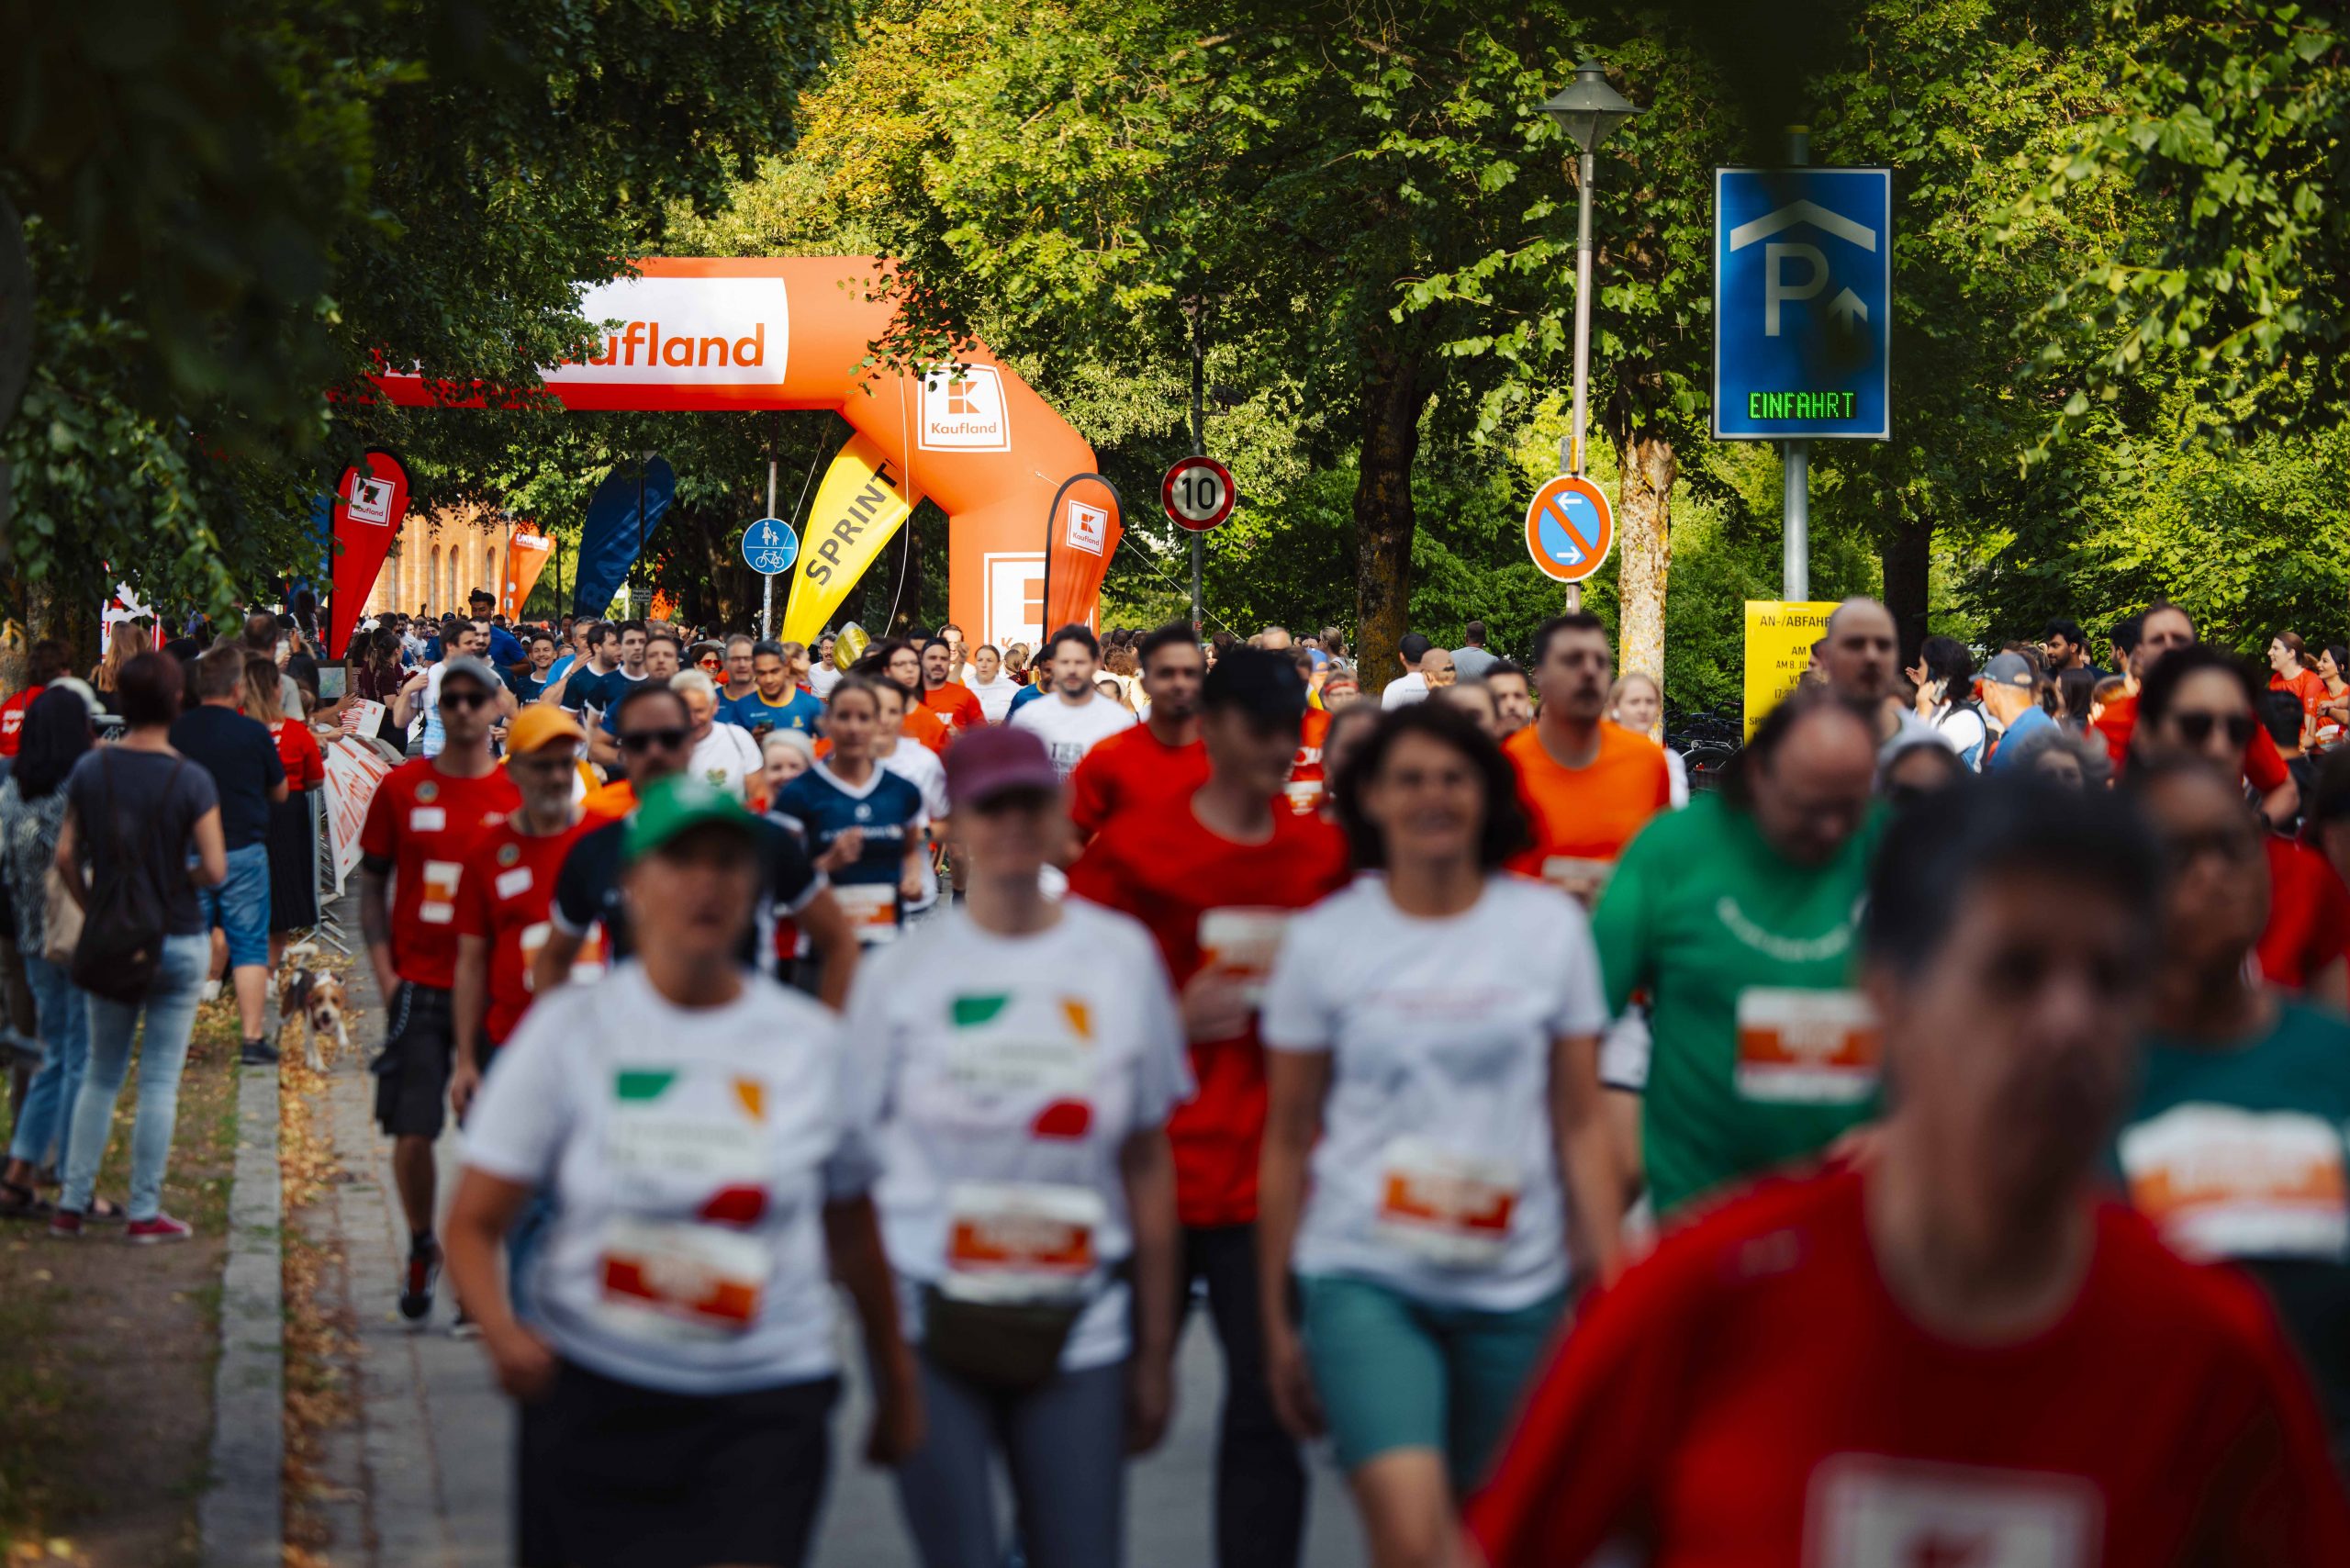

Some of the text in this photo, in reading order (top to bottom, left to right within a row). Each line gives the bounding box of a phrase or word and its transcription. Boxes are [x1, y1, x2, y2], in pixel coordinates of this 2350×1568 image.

[1764, 242, 1830, 337] P
[1749, 392, 1855, 420] EINFAHRT
[931, 422, 997, 434] Kaufland
[1181, 476, 1216, 510] 10
[805, 459, 899, 587] SPRINT
[1072, 531, 1101, 546] Kaufland
[1760, 615, 1832, 628] AN-/ABFAHR
[1791, 645, 1807, 655] AM
[1775, 660, 1788, 669] AM
[1798, 660, 1808, 670] JU
